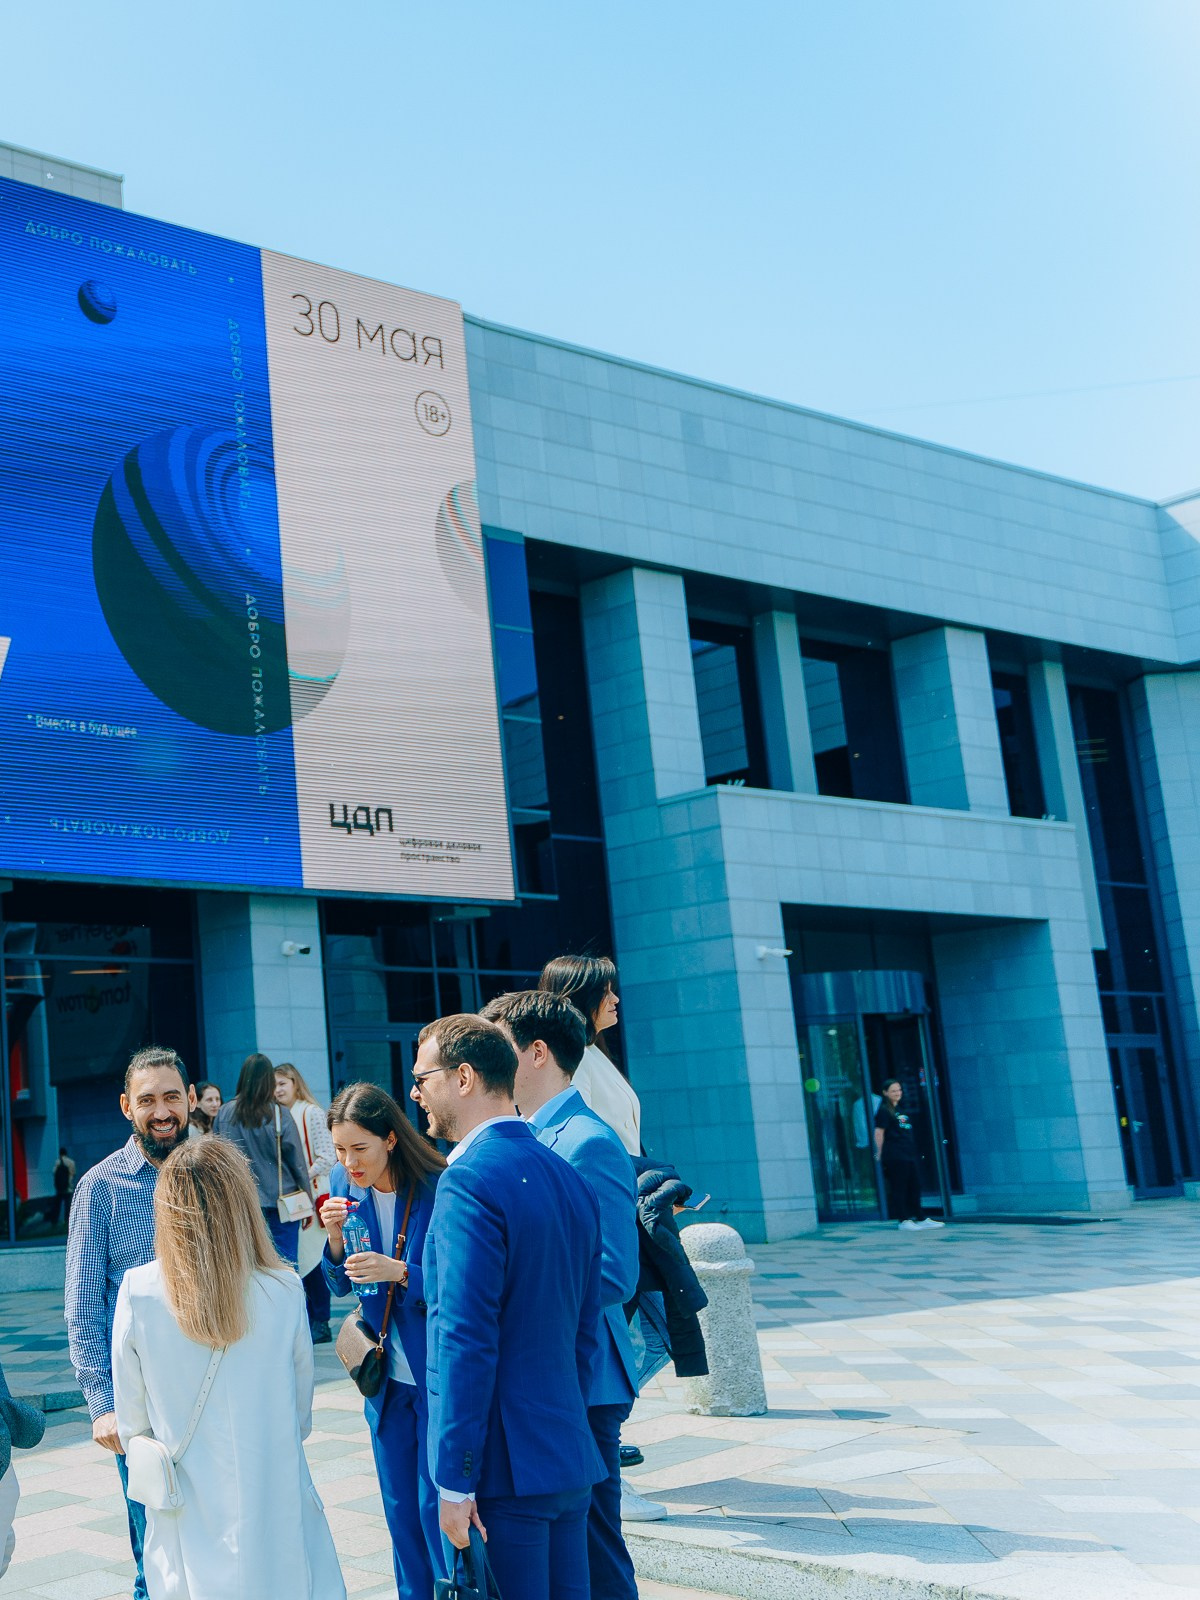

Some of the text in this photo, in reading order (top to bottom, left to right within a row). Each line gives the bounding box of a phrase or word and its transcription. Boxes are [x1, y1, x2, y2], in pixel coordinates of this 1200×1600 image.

[25, 220, 198, 275] ДОБРО ПОЖАЛОВАТЬ
[228, 318, 243, 381] ДОБРО
[292, 294, 444, 369] 30 мая
[423, 403, 446, 423] 18+
[245, 593, 261, 659] ДОБРО
[35, 714, 138, 738] Вместе в будущее
